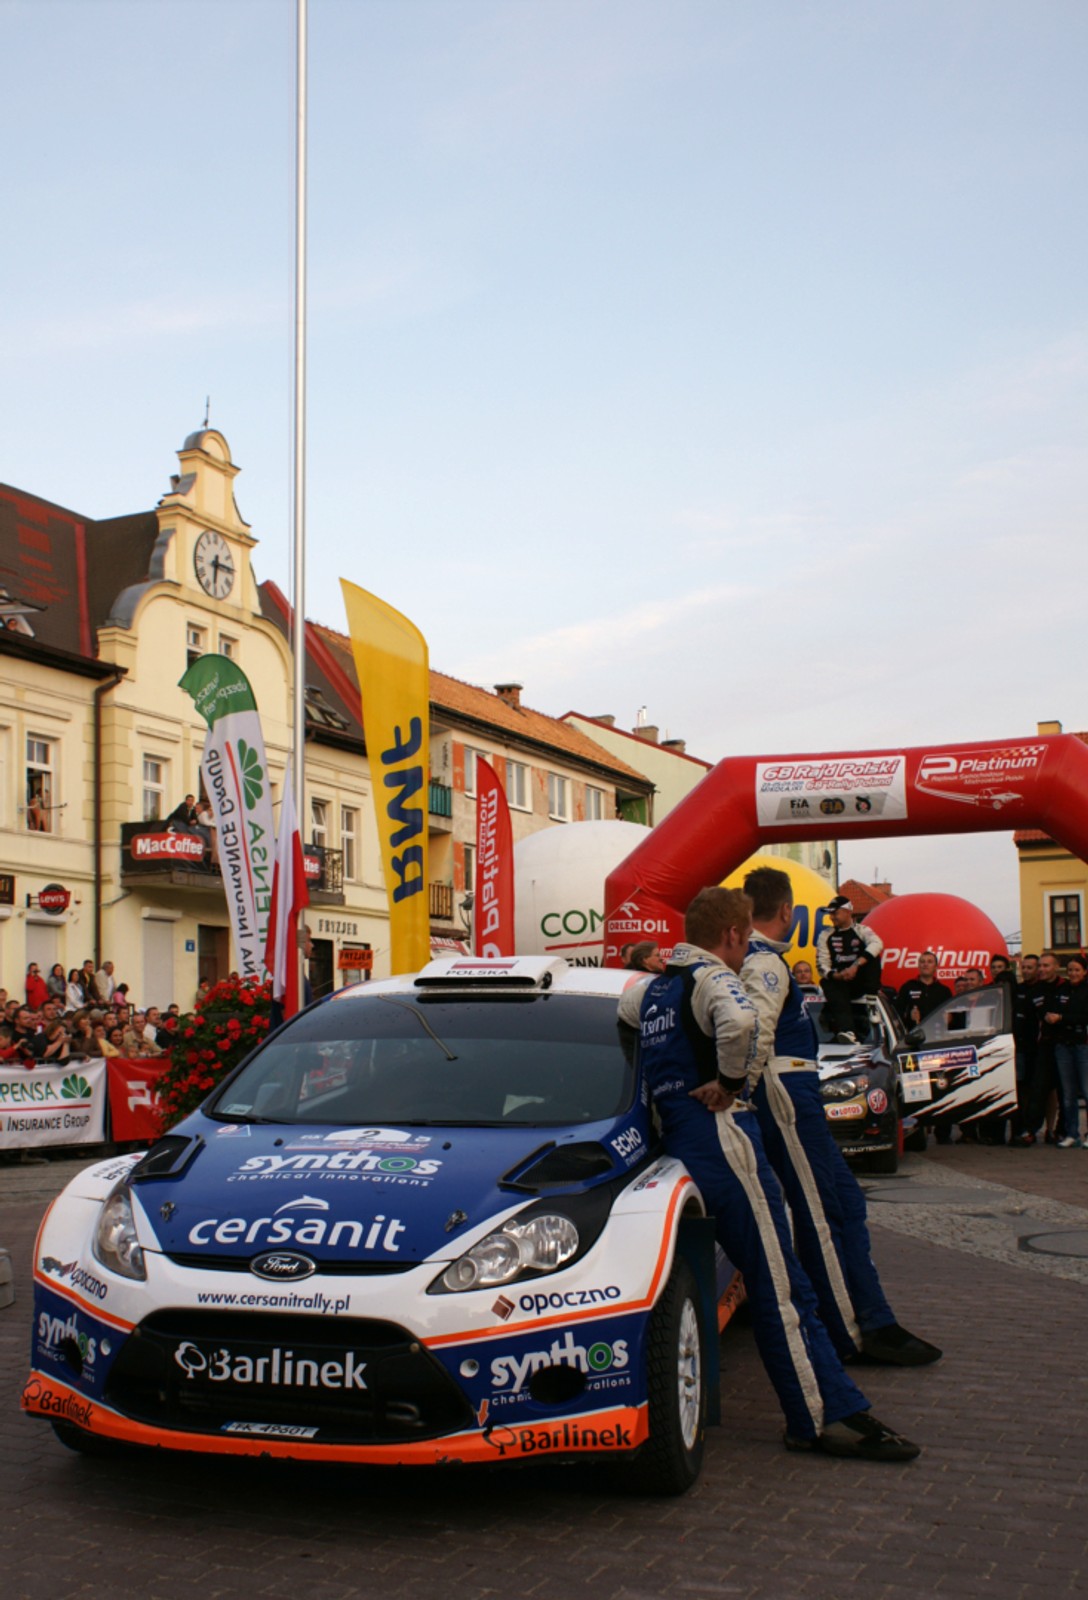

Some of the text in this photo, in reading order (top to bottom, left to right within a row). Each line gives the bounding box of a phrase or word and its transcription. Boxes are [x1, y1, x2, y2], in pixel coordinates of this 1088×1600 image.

[763, 759, 900, 781] 68 Rajd Polski
[958, 756, 1037, 773] Platinum
[137, 836, 203, 855] MacCoffee
[318, 918, 358, 936] FRYZJER
[643, 920, 670, 932] OIL
[905, 1054, 915, 1072] 4
[969, 1065, 979, 1076] R
[7, 1113, 90, 1131] INSURANCE GROUP
[359, 1130, 381, 1140] 2
[610, 1127, 641, 1157] ECHO
[239, 1150, 442, 1175] synthos
[227, 1172, 429, 1187] chemical innovations
[188, 1215, 406, 1251] cersanit
[263, 1256, 299, 1273] Ford
[198, 1292, 351, 1314] www.cersanitrally.pl
[520, 1286, 621, 1315] opoczno
[208, 1347, 368, 1390] Barlinek
[39, 1389, 95, 1428] Barlinek
[520, 1424, 632, 1453] Barlinek
